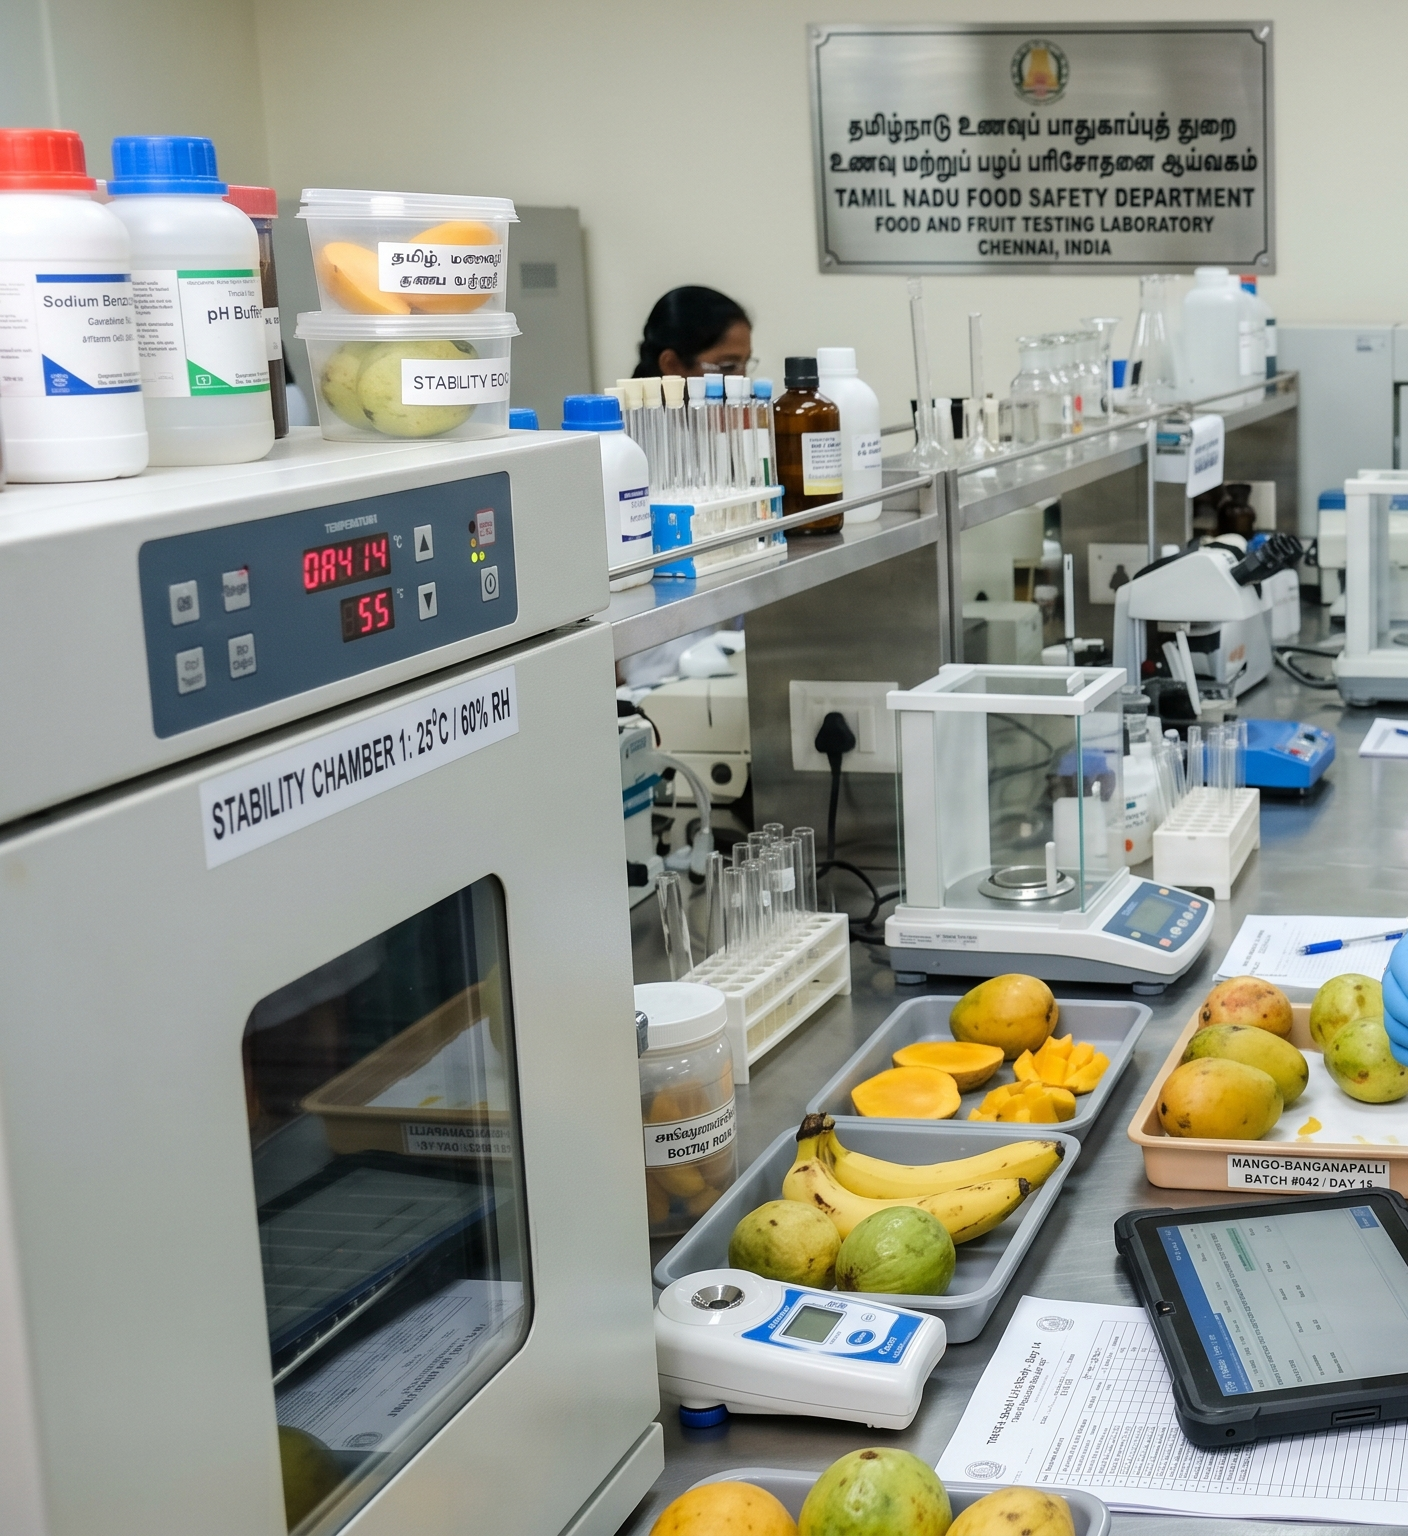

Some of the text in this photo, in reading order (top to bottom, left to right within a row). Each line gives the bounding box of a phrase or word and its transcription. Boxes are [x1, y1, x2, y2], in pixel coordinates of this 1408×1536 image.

[848, 111, 1237, 145] தமிழ்நாடு உணவுப் பாதுகாப்புத் துறை
[830, 152, 897, 177] உணவு
[978, 148, 1021, 180] பழப்
[1162, 146, 1258, 178] ஆய்வகம்
[835, 187, 1255, 208] TAMIL NADU FOOD SAFETY DEPARTMENT
[875, 216, 1214, 233] FOOD AND FRUIT TESTING LABORATORY
[978, 239, 1112, 260] CHENNAI, INDIA
[43, 295, 99, 308] Sodium
[207, 306, 230, 325] pH
[413, 373, 488, 391] STABILITY
[358, 592, 390, 634] 55
[212, 767, 306, 841] STABILITY
[311, 733, 396, 799] CHAMBER
[399, 727, 413, 762] 1:
[461, 696, 489, 736] 60%
[491, 686, 511, 724] RH
[1232, 1158, 1386, 1175] MANGO-BANGANAPALLI
[1244, 1173, 1287, 1186] BATCH
[1291, 1176, 1319, 1188] #042
[1329, 1178, 1356, 1189] DAY
